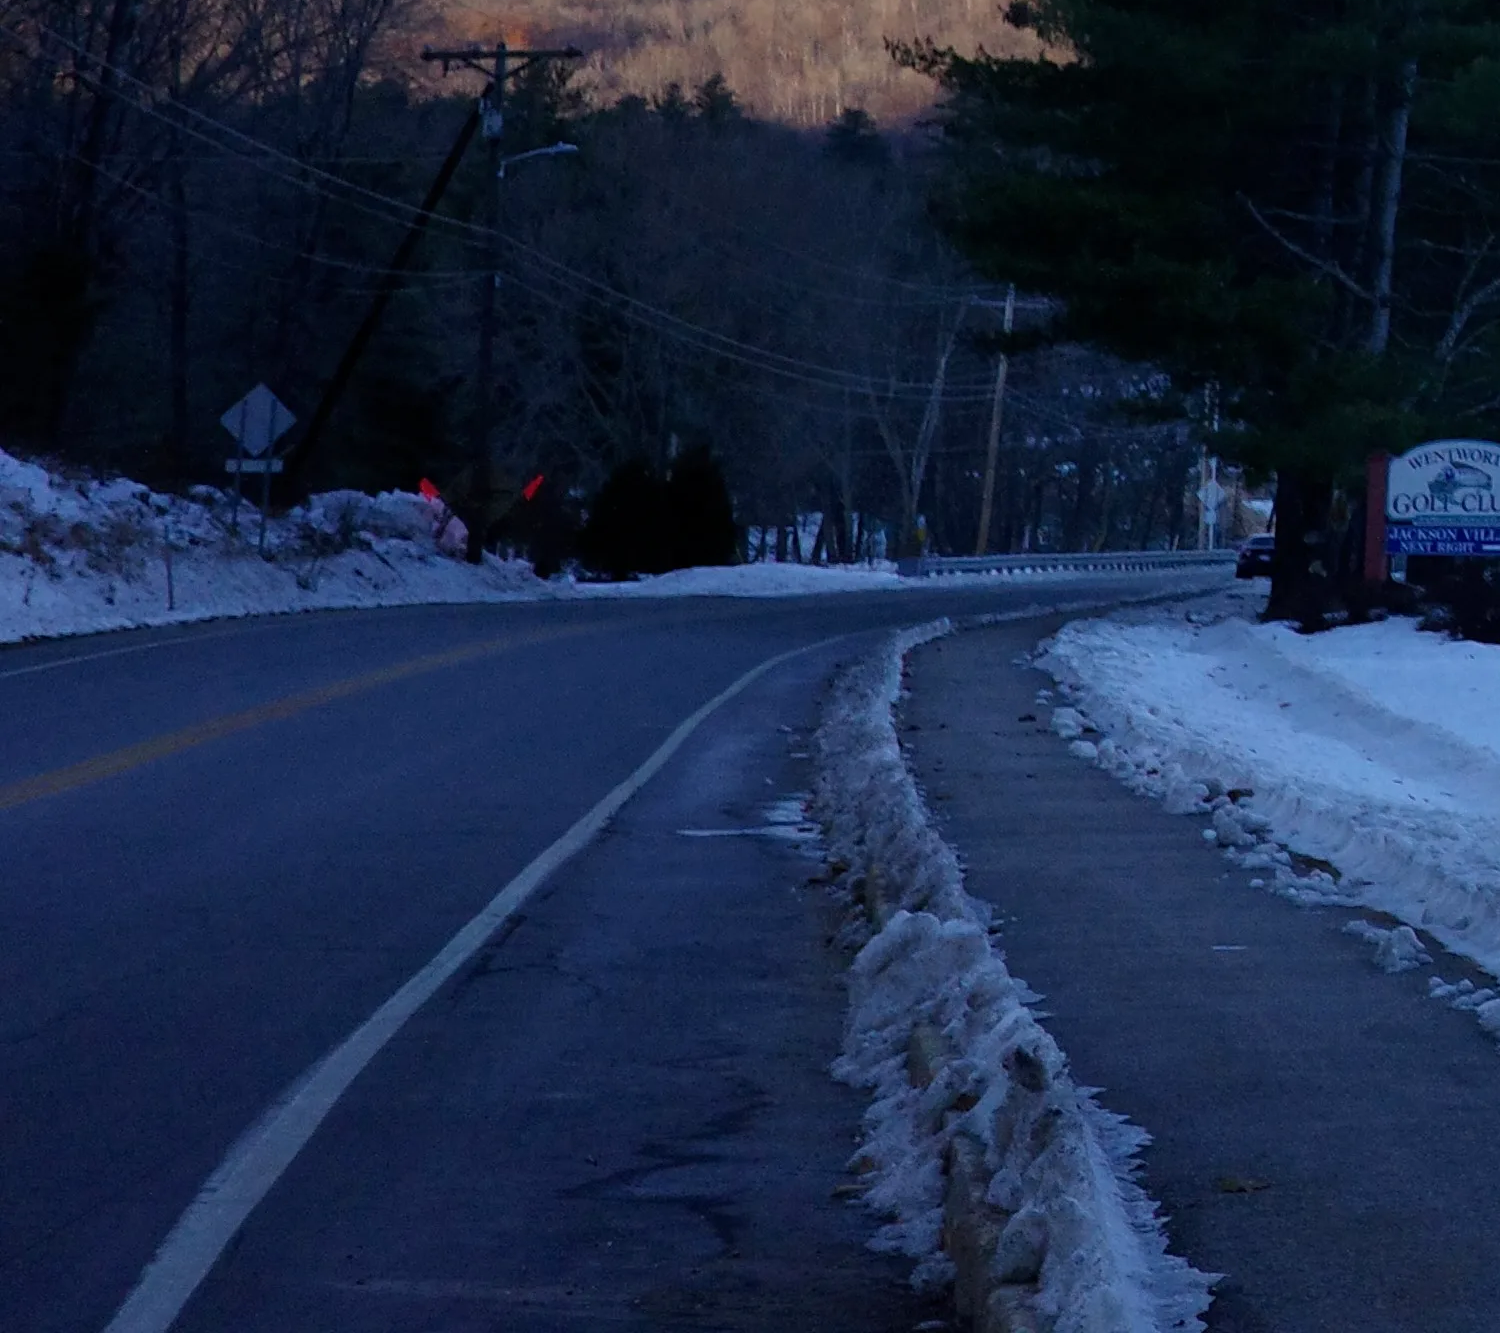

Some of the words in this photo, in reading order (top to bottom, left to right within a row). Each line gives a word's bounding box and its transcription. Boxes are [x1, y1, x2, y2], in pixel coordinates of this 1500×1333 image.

[1393, 492, 1452, 514] GOLF
[1388, 527, 1458, 541] JACKSON
[1399, 541, 1433, 553] NEXT
[1436, 541, 1476, 553] RIGHT
